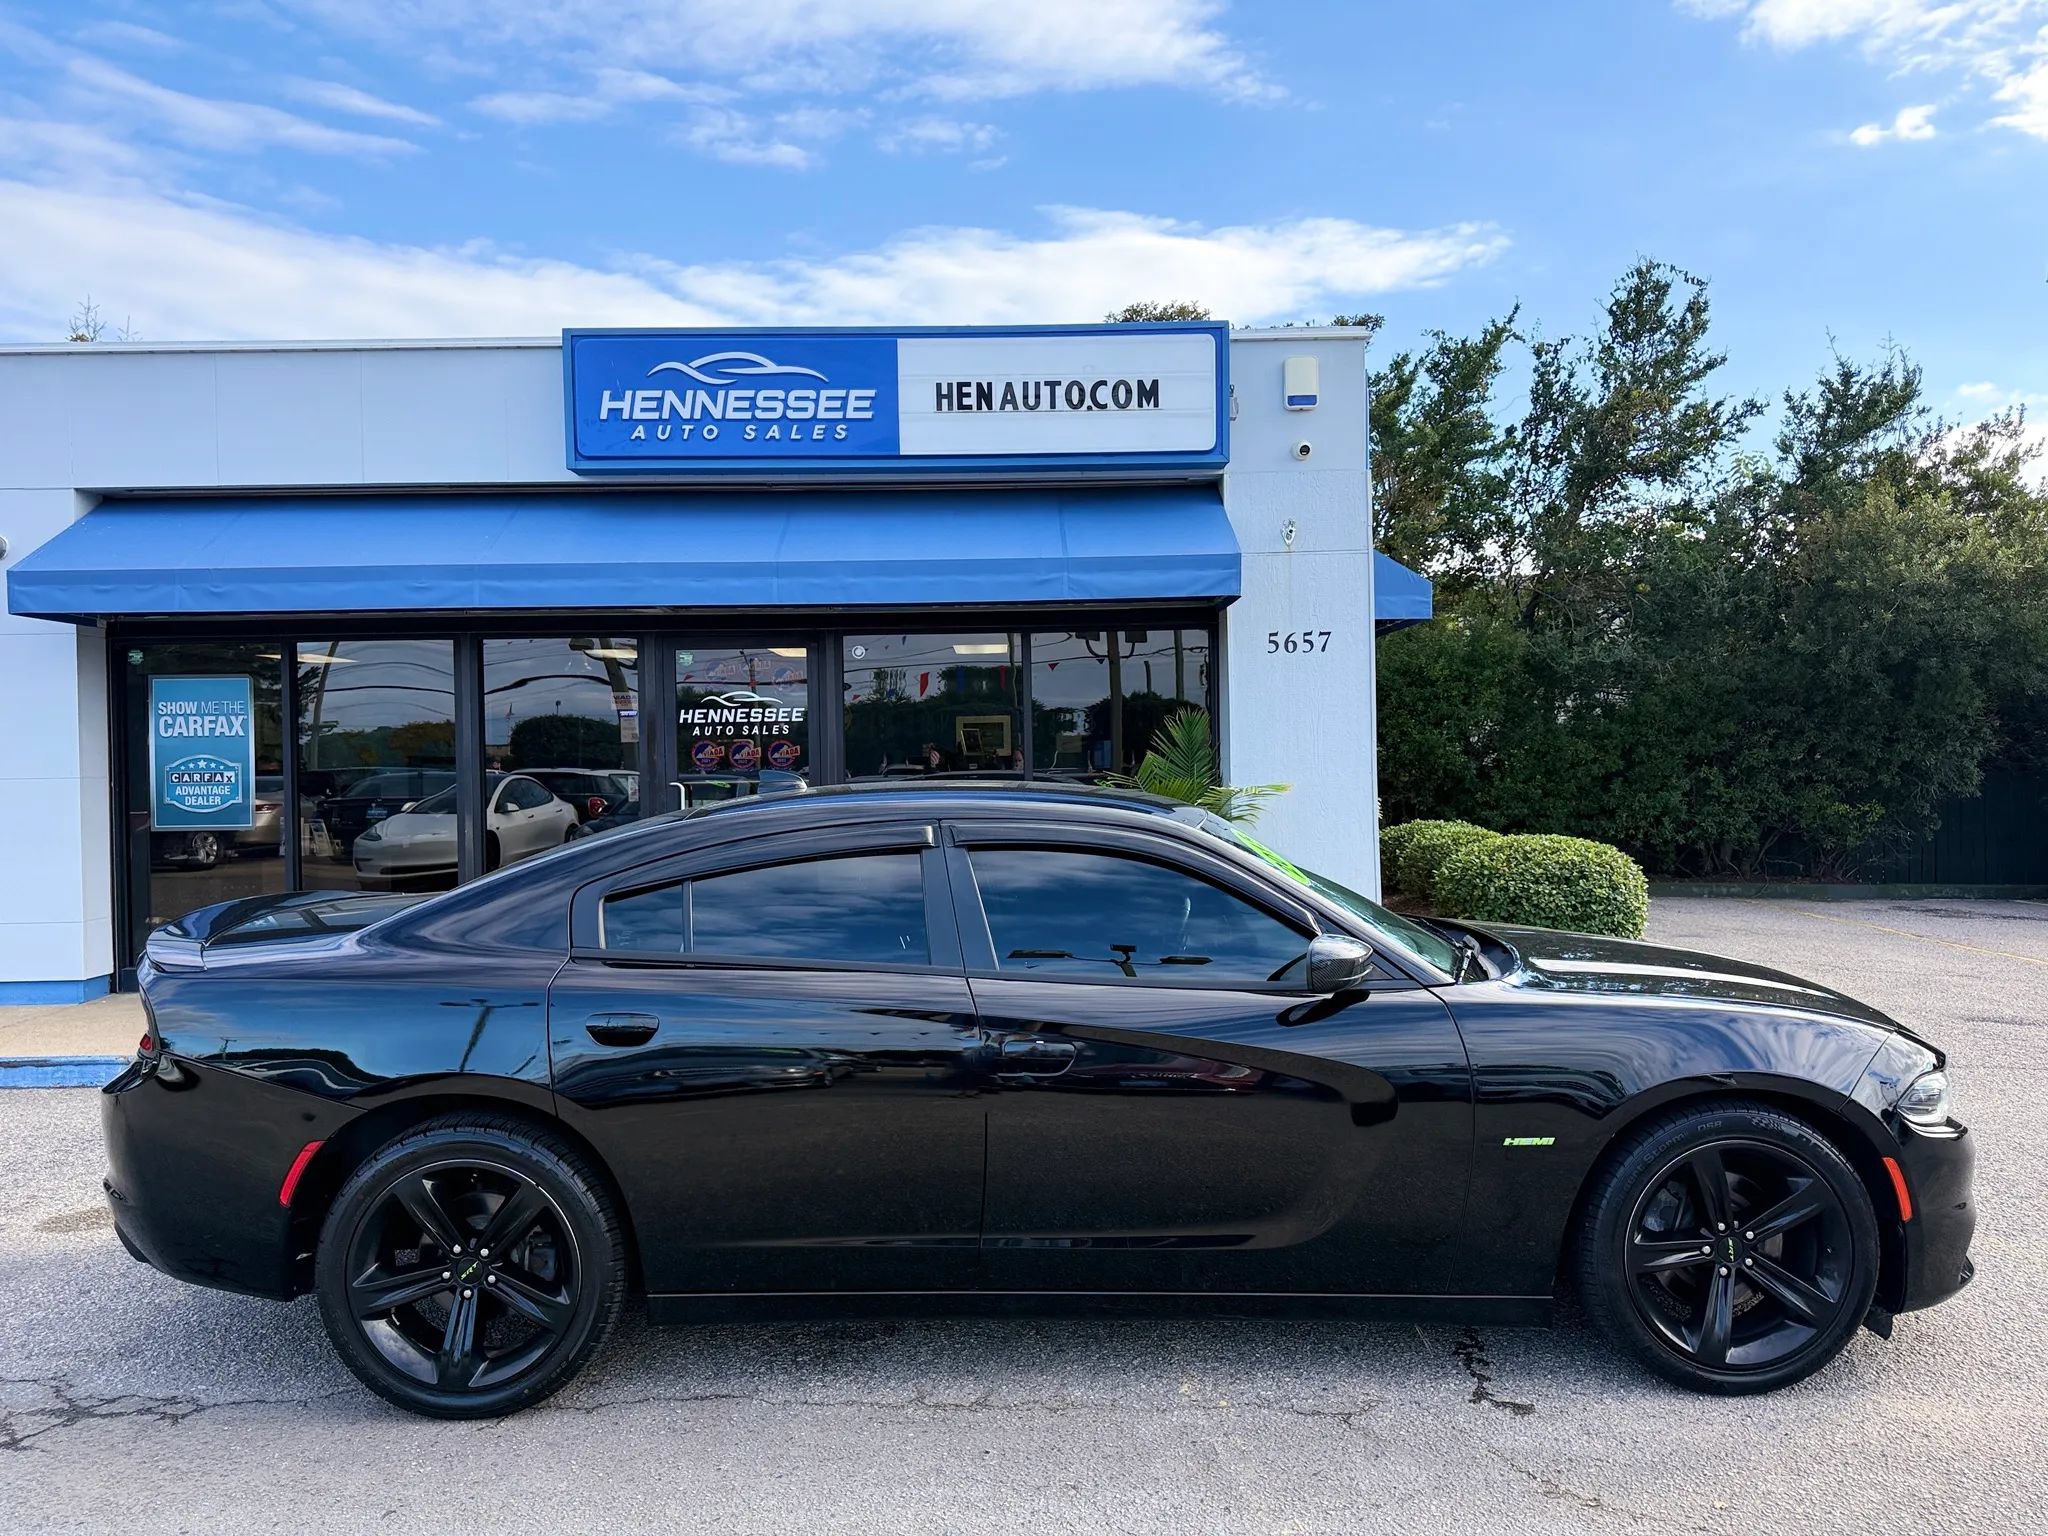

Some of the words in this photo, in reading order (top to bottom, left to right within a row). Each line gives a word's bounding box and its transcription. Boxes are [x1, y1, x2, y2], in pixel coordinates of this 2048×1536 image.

[934, 378, 1160, 412] HENAUTO.COM
[599, 389, 877, 420] HENNESSEE
[630, 424, 720, 441] AUTO
[743, 424, 849, 441] SALES
[1267, 630, 1332, 654] 5657
[158, 701, 198, 715] SHOW
[201, 700, 220, 714] ME
[221, 700, 245, 714] THE
[679, 707, 806, 723] HENNESSEE
[159, 715, 246, 737] CARFAX
[692, 725, 735, 737] AUTO
[742, 724, 790, 736] SALES
[171, 773, 234, 784] CARFAX
[175, 785, 231, 796] ADVANTAGE
[185, 796, 222, 806] DEALER
[1502, 1137, 1556, 1146] HEMI
[460, 1260, 479, 1280] SRT
